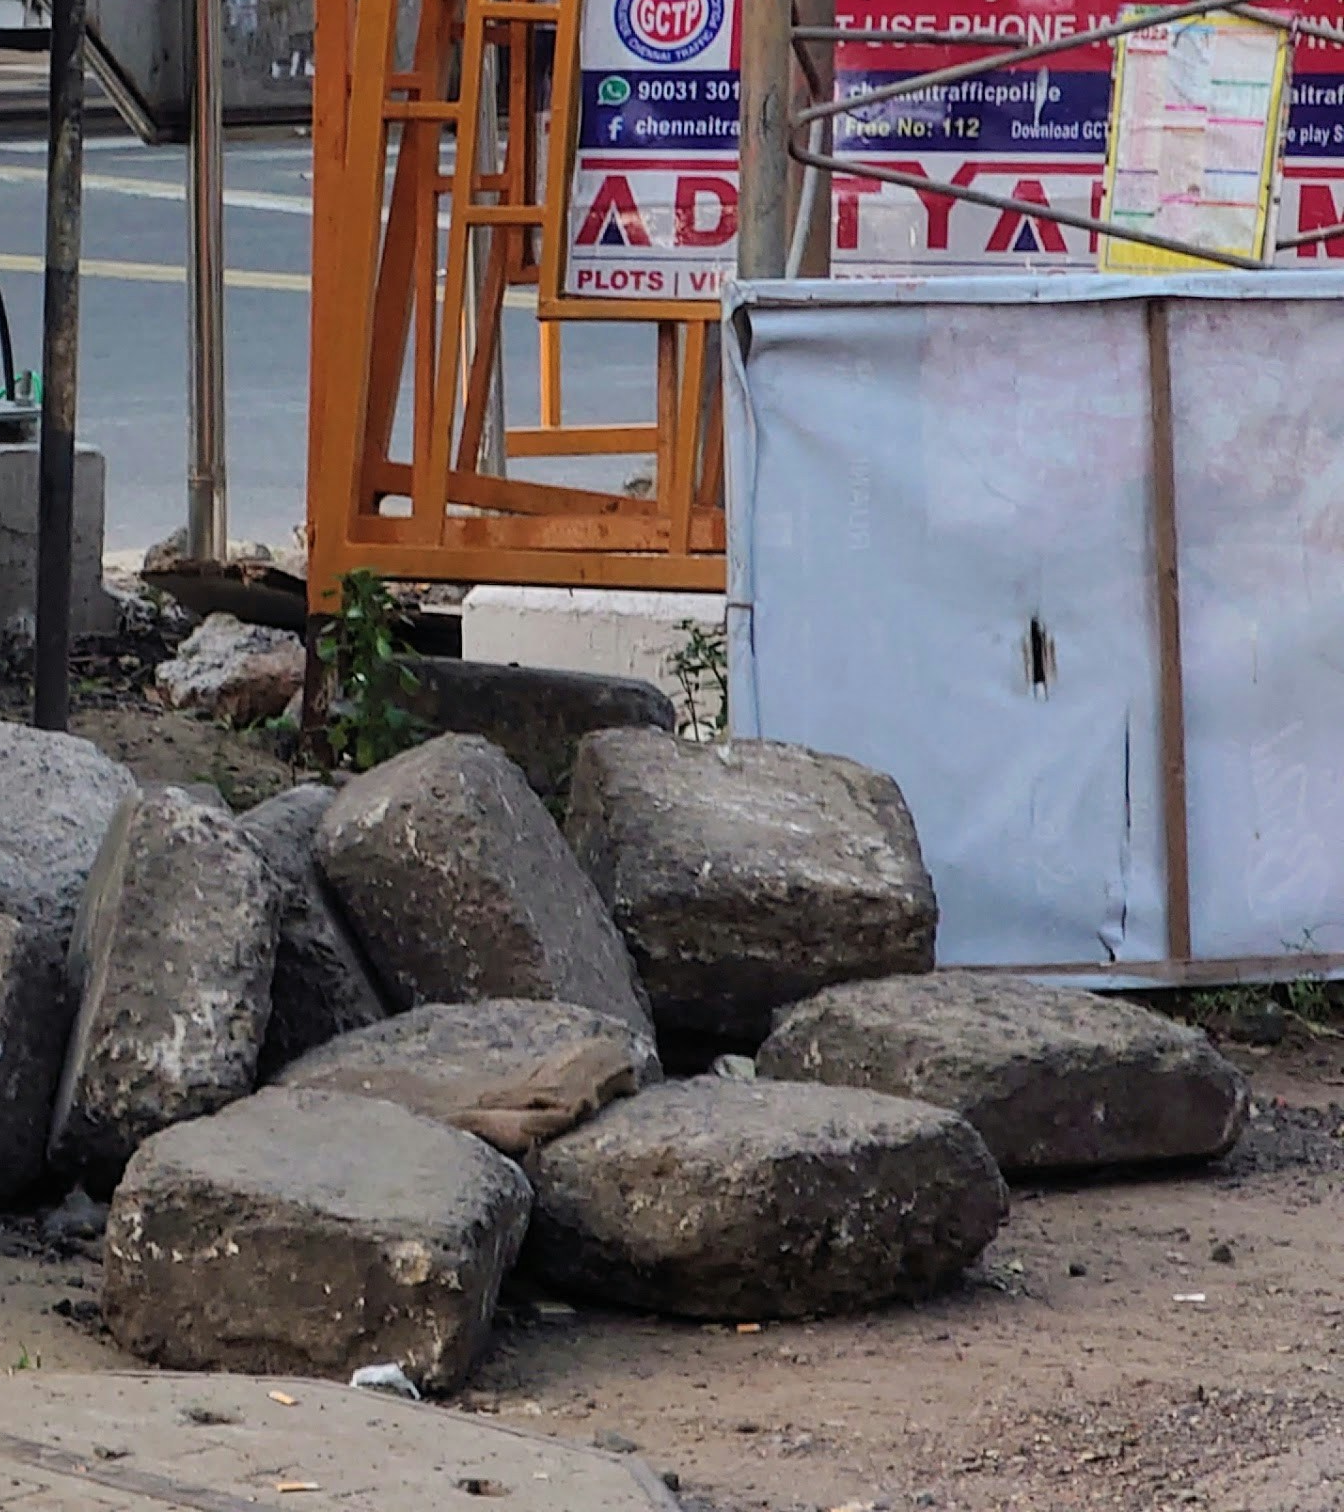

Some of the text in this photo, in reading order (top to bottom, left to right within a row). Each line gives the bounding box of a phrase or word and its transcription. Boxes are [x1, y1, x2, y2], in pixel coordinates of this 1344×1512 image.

[638, 81, 740, 101] 90031 301
[635, 116, 741, 136] chennaitra
[943, 117, 981, 138] 112
[1011, 120, 1079, 140] Download
[1300, 123, 1330, 147] play
[577, 270, 664, 291] PLOTS
